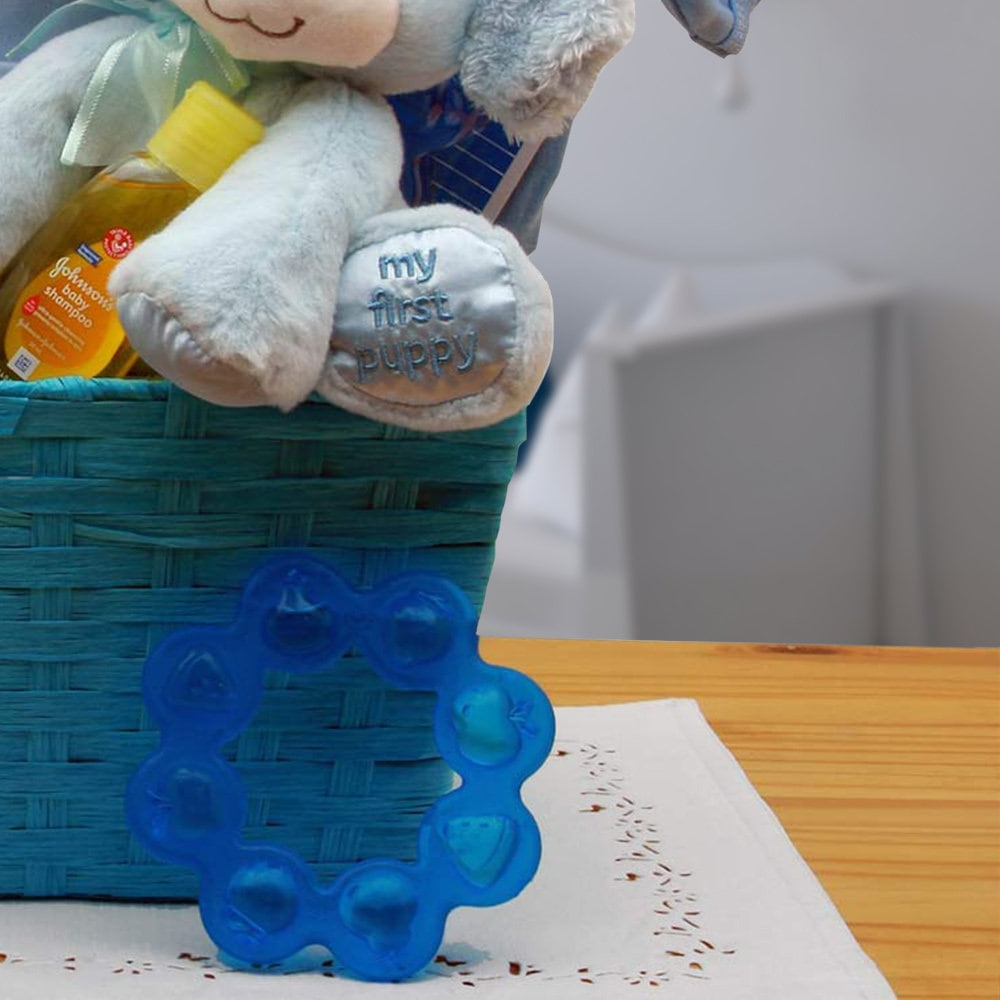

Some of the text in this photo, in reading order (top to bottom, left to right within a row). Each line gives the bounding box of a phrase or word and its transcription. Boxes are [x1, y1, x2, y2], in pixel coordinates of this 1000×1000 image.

[378, 247, 438, 285] my
[43, 285, 93, 329] shampoo
[60, 283, 91, 312] baby
[367, 286, 455, 329] first
[356, 330, 479, 384] puppy
